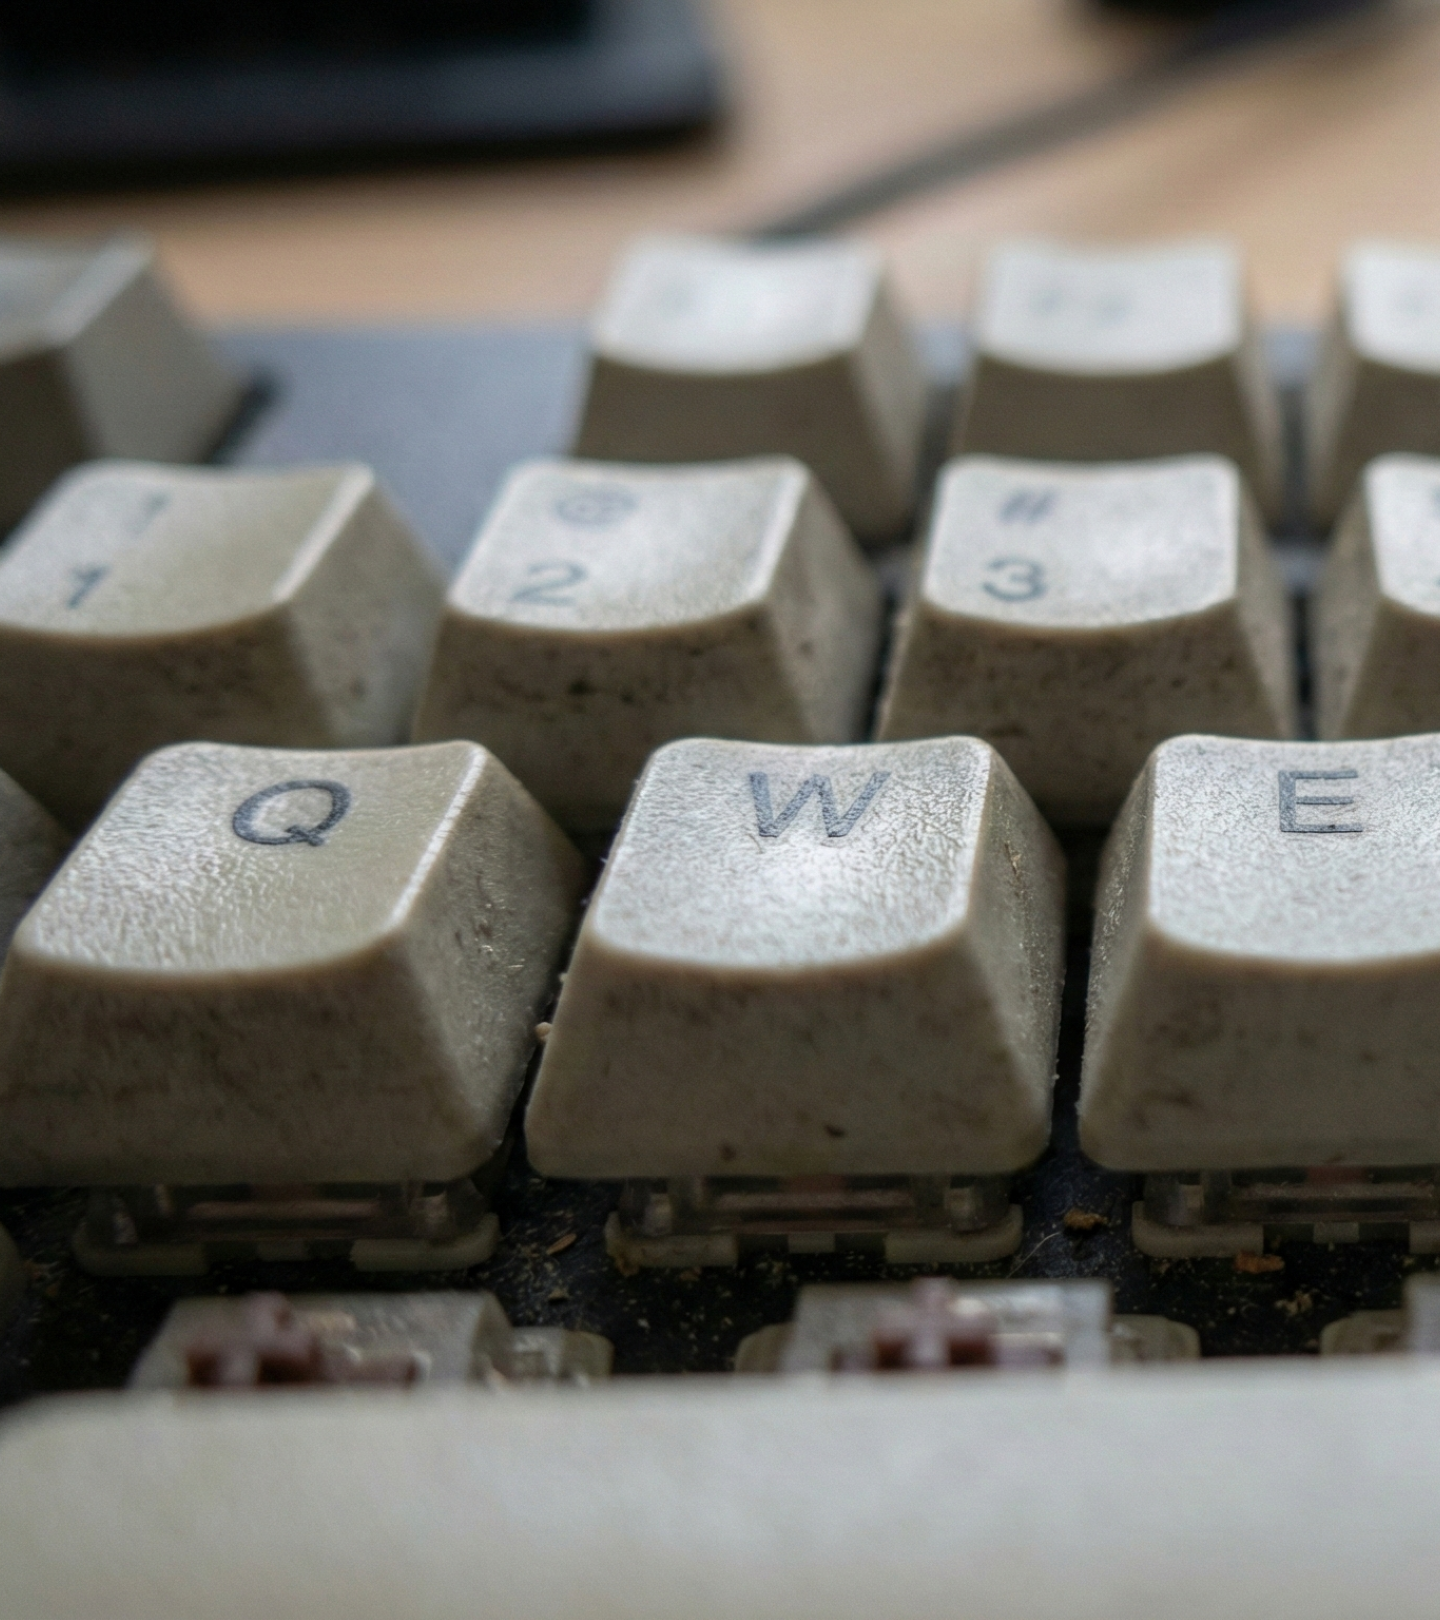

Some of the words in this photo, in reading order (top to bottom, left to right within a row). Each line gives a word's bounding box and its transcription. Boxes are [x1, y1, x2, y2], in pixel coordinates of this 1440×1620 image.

[64, 564, 108, 612] 1
[510, 562, 588, 608] 2
[980, 558, 1048, 602] 3
[230, 778, 352, 848] Q
[746, 772, 890, 840] W
[1276, 768, 1361, 836] E
